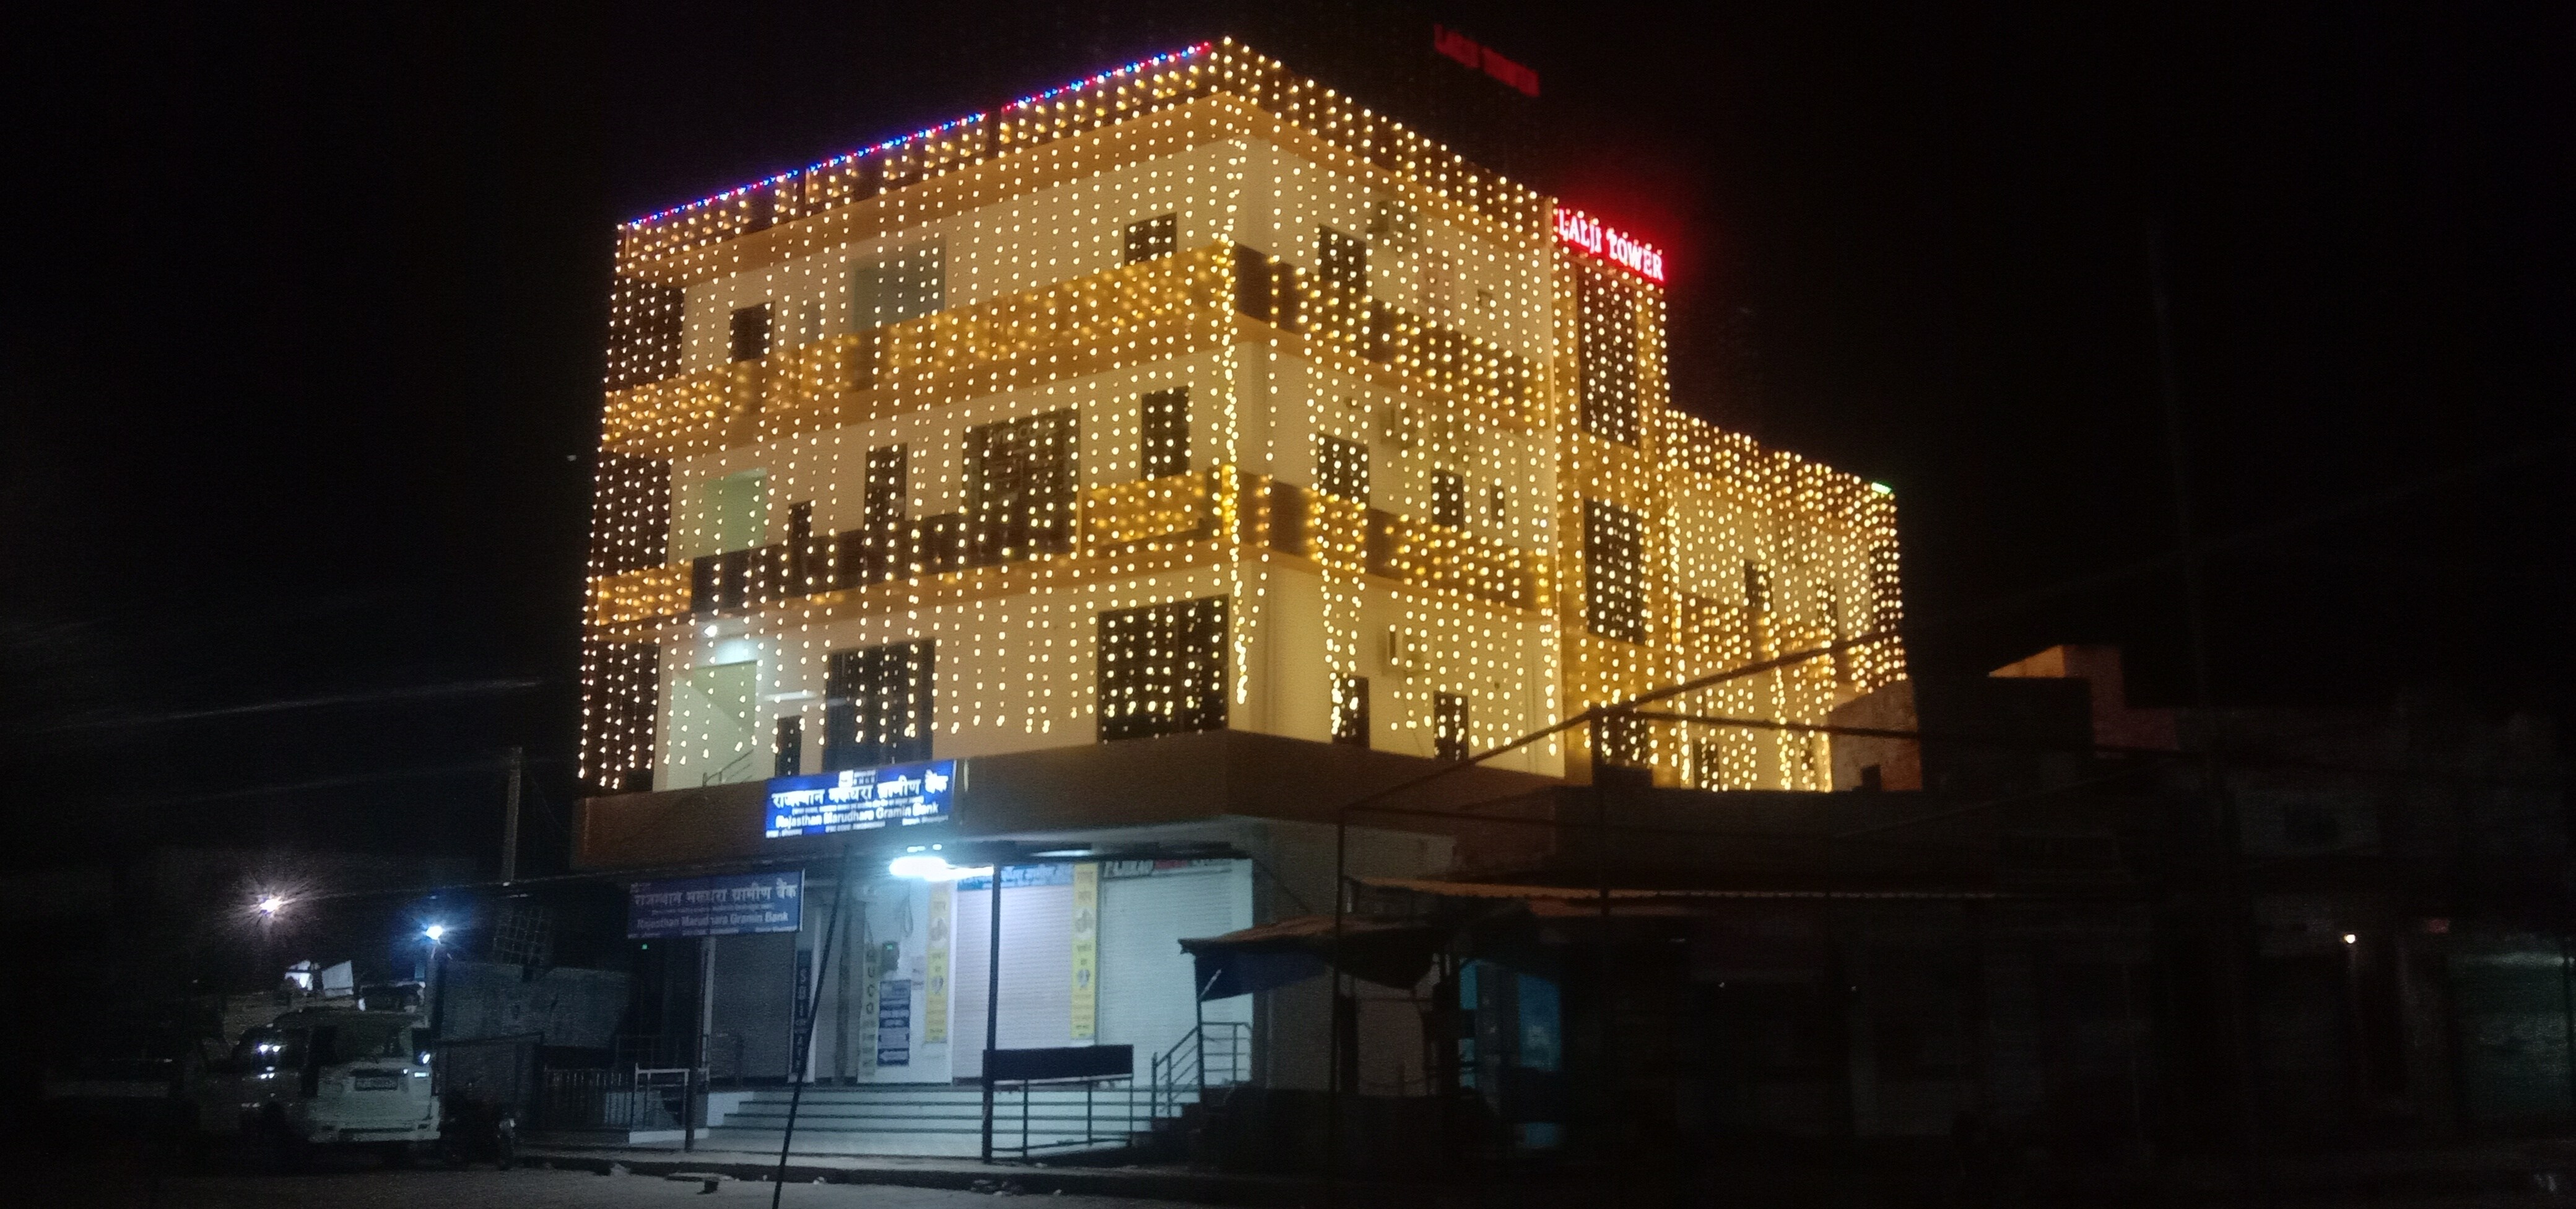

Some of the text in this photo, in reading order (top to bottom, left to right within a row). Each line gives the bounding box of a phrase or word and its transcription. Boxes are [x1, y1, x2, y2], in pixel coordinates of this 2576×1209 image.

[1606, 230, 1664, 282] TOWER
[776, 813, 822, 829] Rajasthan
[824, 809, 874, 824] Marudhara
[876, 805, 912, 819] Gramin
[913, 801, 939, 816] Bank
[775, 877, 798, 899] बैंक
[765, 912, 789, 923] Bank
